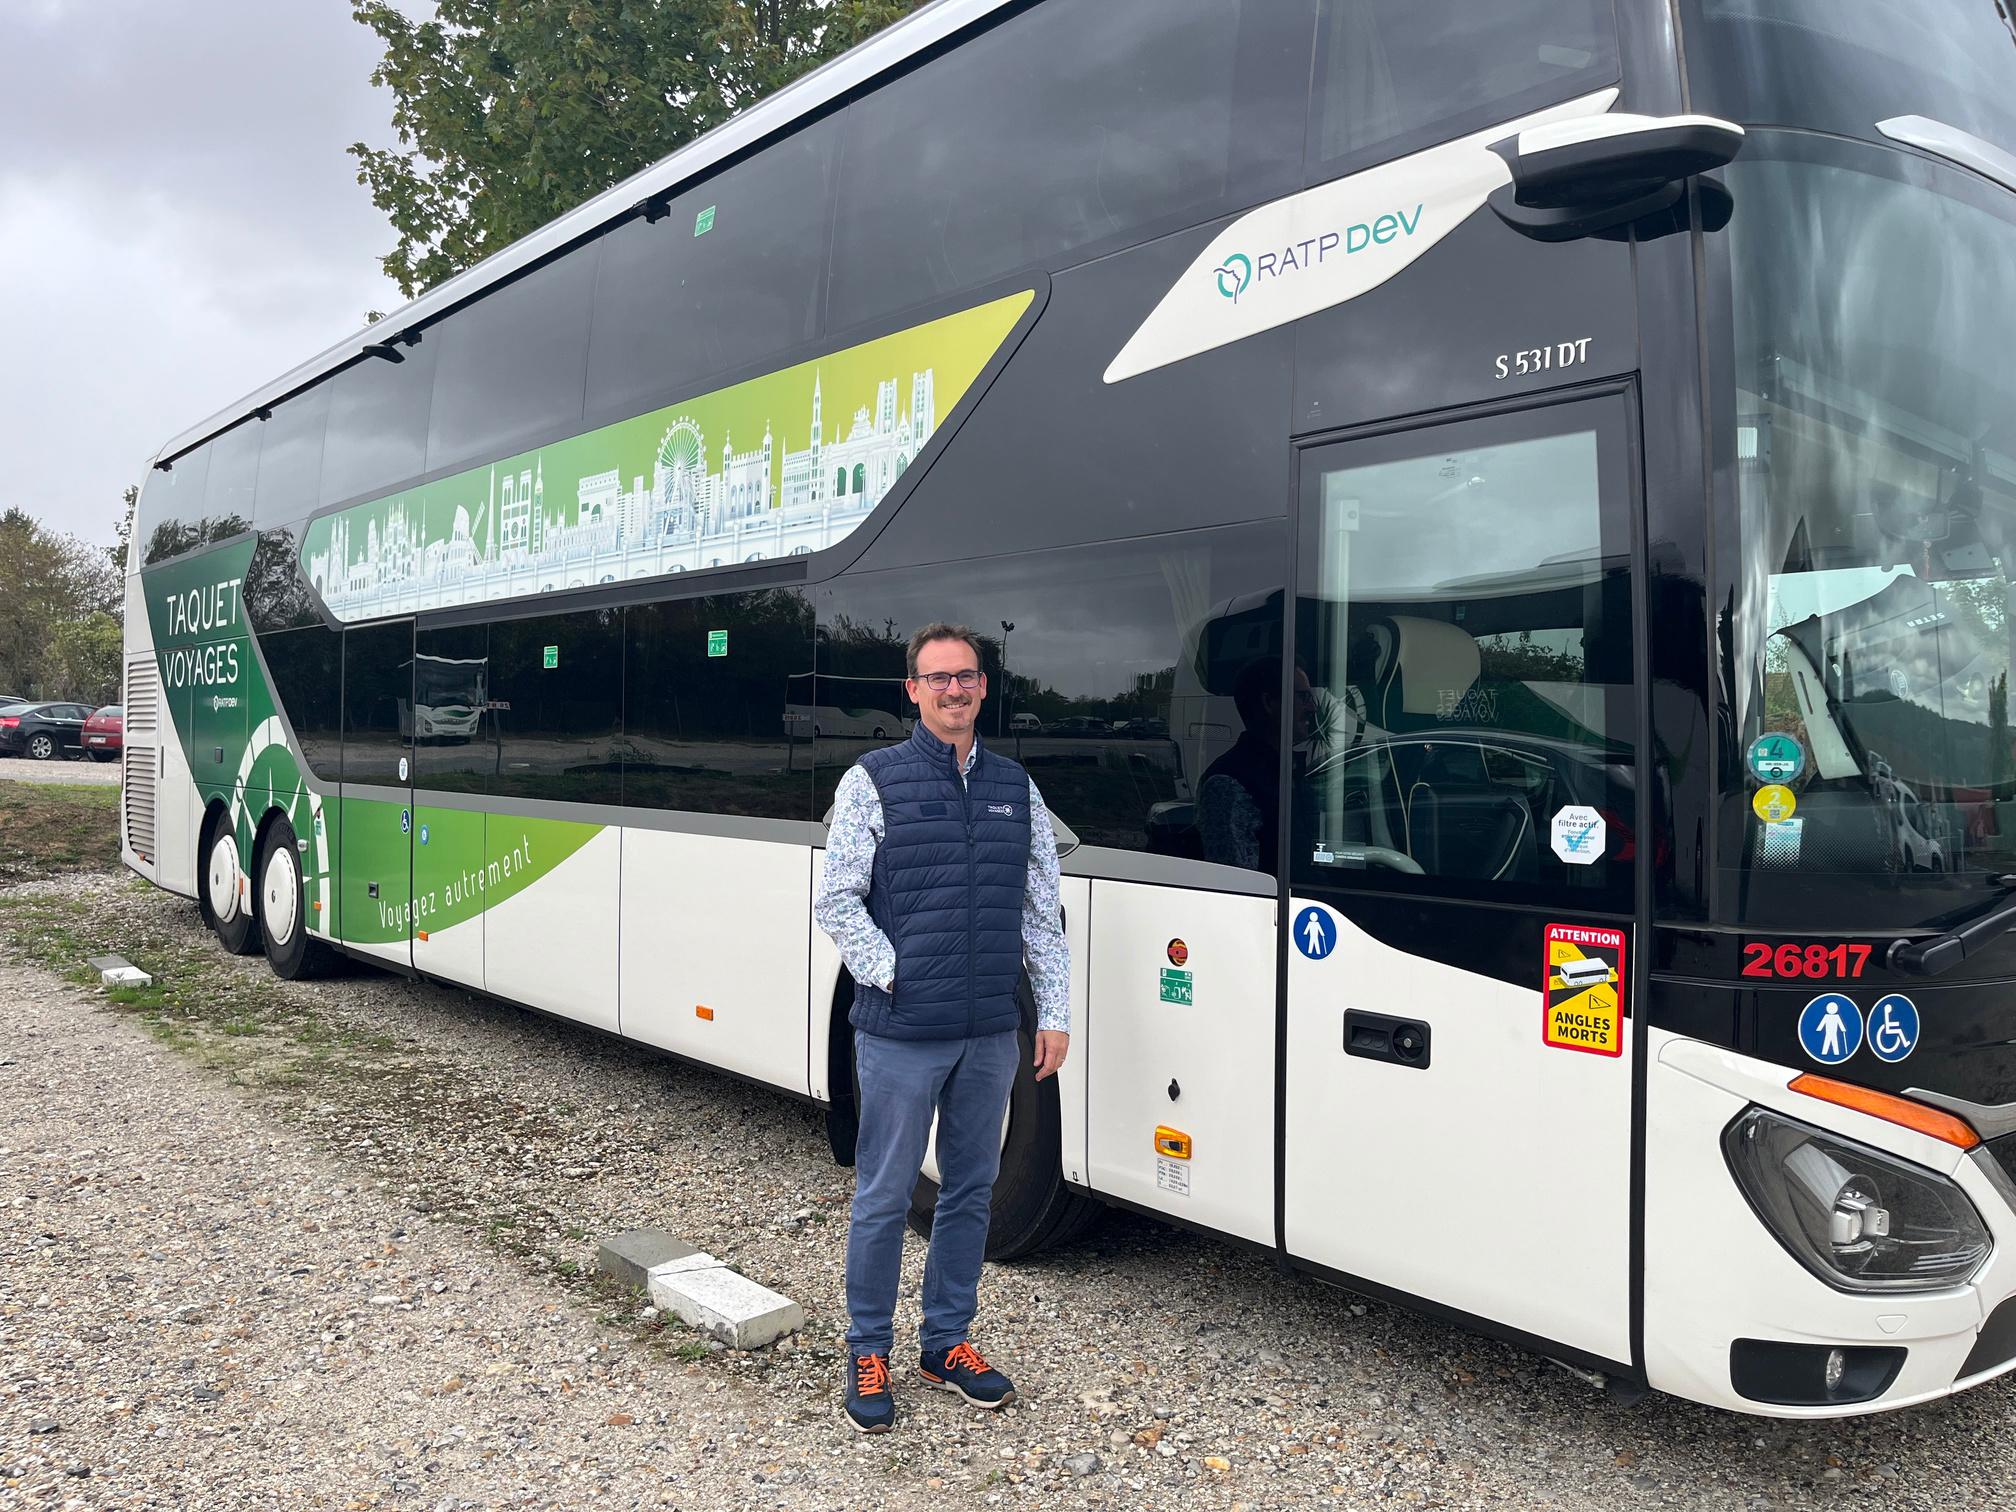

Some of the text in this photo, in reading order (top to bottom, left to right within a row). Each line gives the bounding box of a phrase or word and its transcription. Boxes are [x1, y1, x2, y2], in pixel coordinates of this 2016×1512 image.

[1257, 232, 1339, 282] RATP
[1495, 337, 1592, 380] S 531 DT
[167, 578, 241, 636] TAQUET
[1906, 612, 1945, 627] SETRA
[165, 643, 238, 688] VOYAGES
[1769, 739, 1784, 759] 4
[1767, 791, 1781, 805] 2
[1558, 820, 1577, 828] filtre
[1569, 813, 1588, 821] Avec
[378, 834, 532, 932] Voyagez autrement
[1550, 928, 1620, 946] ATTENTION
[1741, 943, 1872, 978] 26817
[1555, 1011, 1611, 1031] ANGLES
[1557, 1025, 1608, 1044] MORTS
